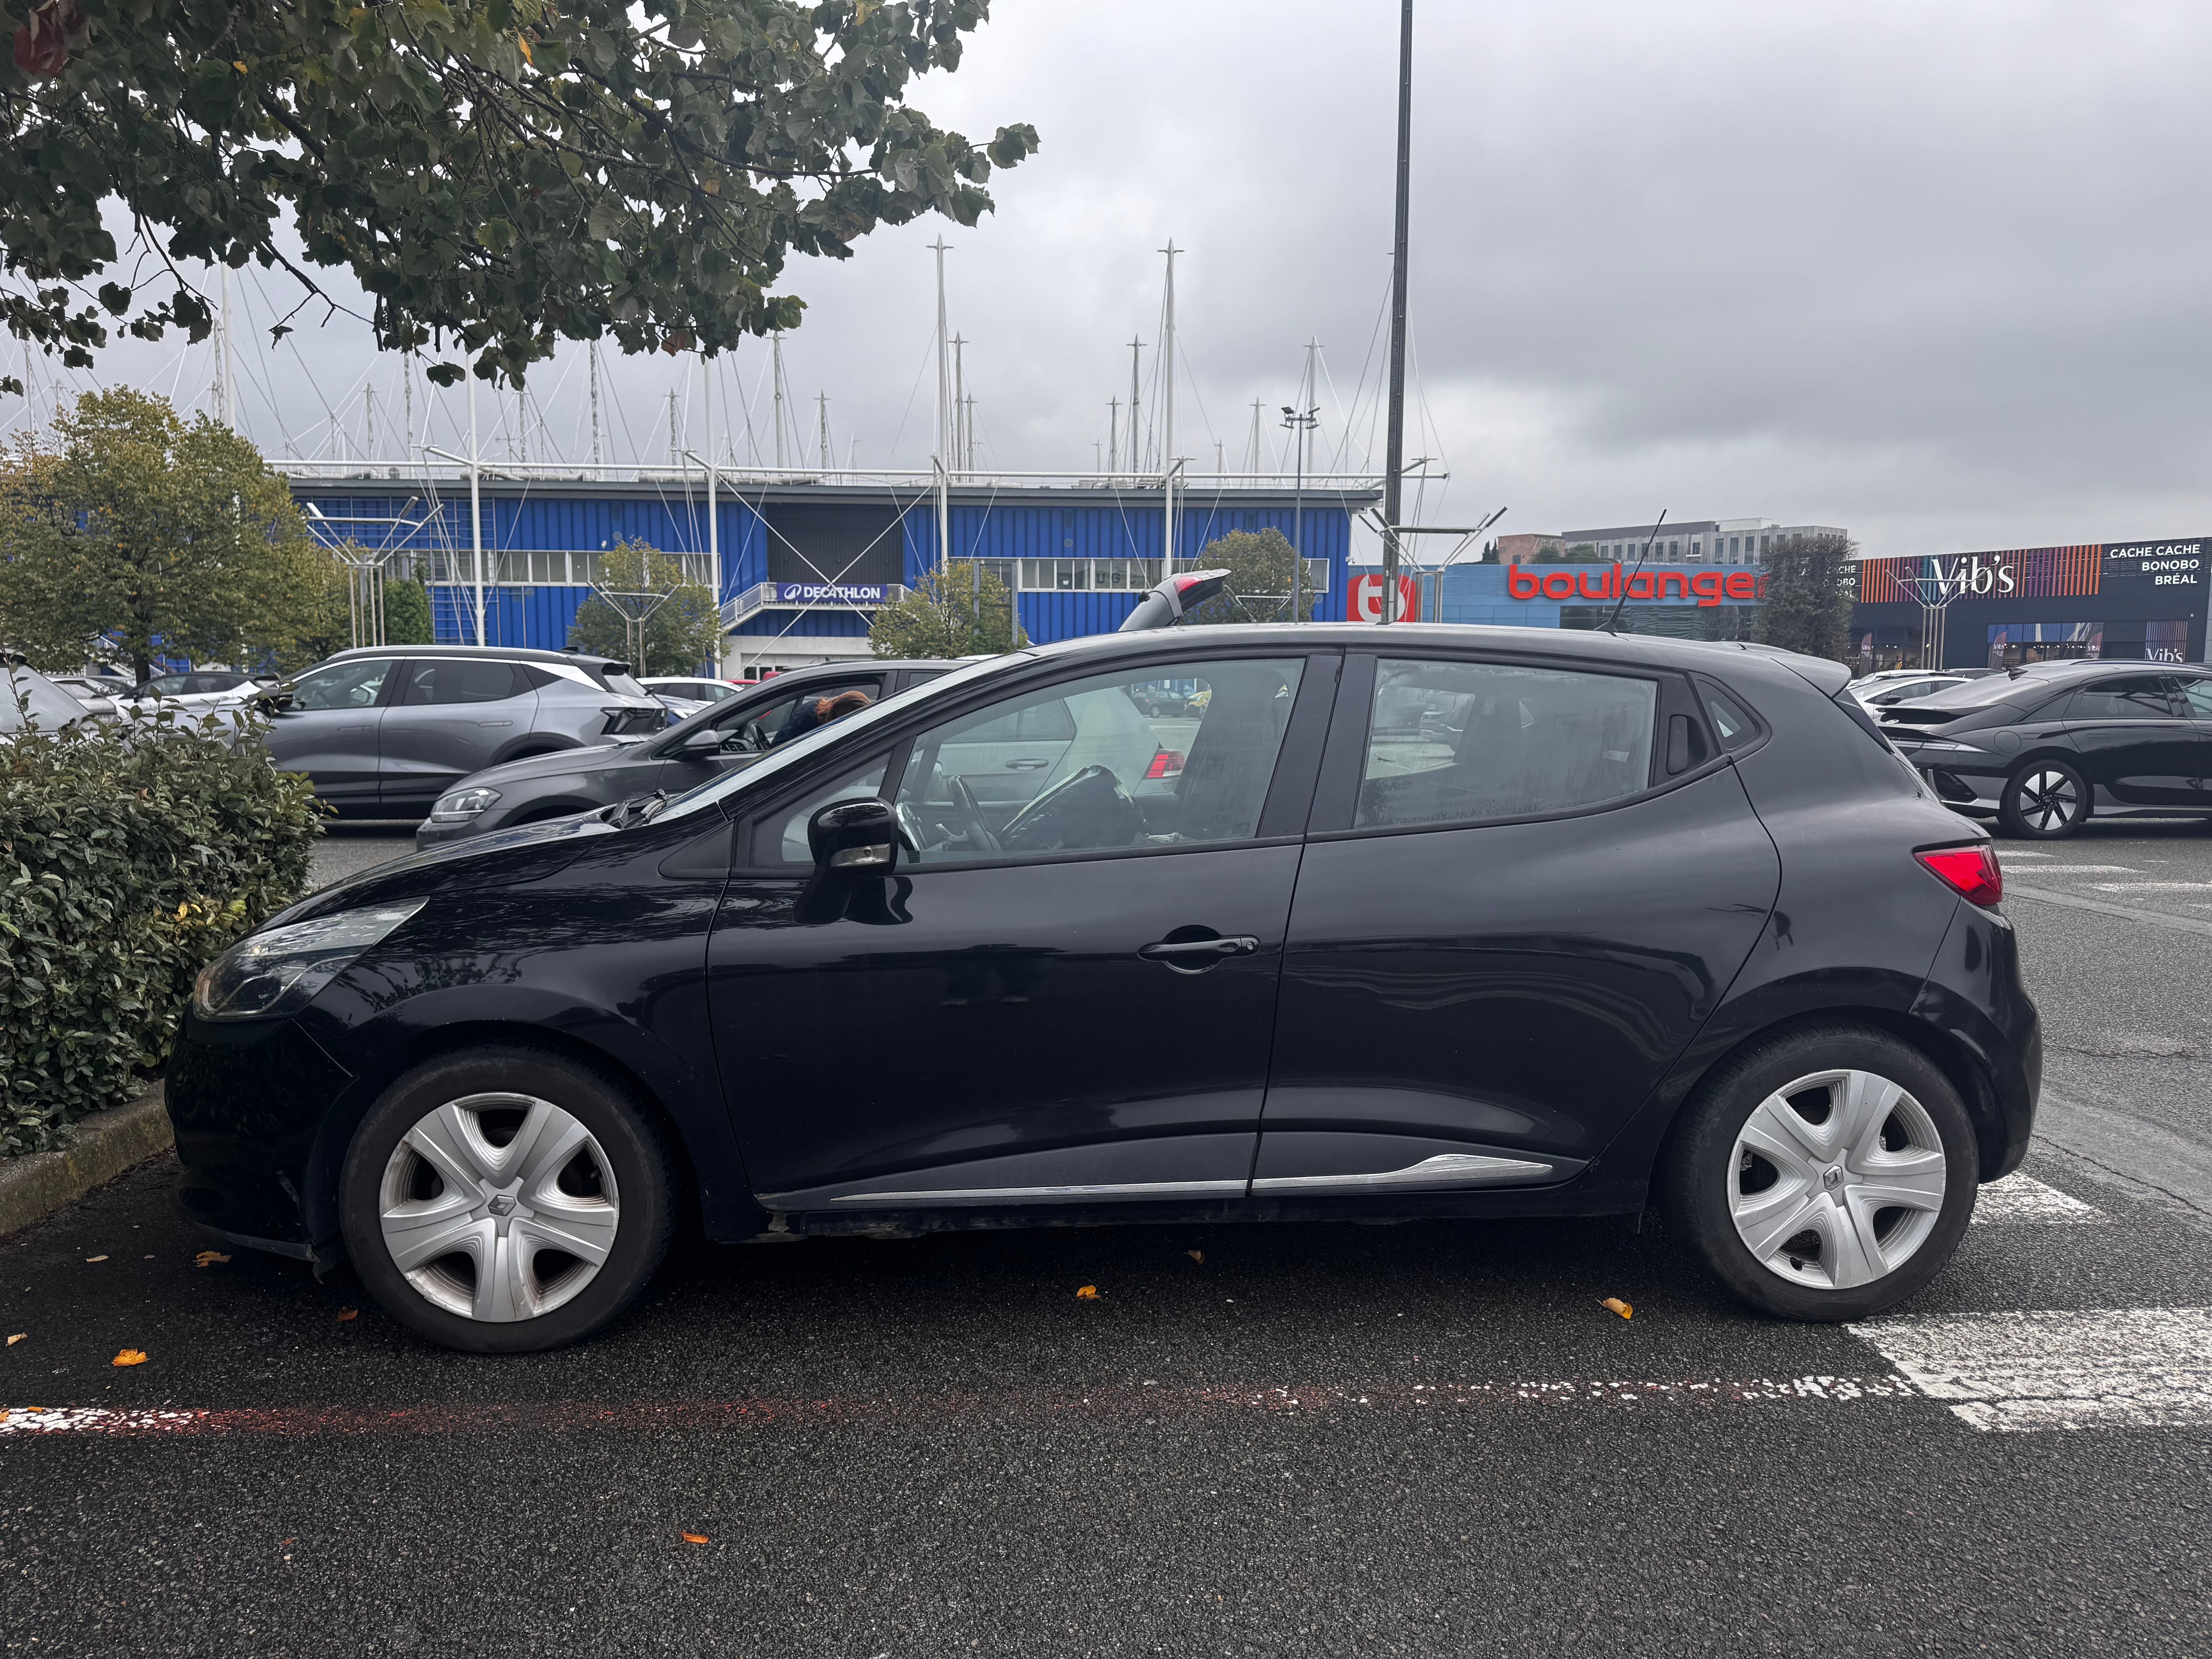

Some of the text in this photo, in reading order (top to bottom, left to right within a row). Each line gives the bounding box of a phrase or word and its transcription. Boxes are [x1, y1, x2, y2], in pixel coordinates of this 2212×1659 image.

[2111, 544, 2200, 558] CACHE CACHE
[2142, 559, 2199, 571] BONOBO
[1931, 555, 2014, 595] Vib's
[2155, 572, 2197, 585] BRÉAL
[804, 586, 880, 599] DECATHLON
[2147, 648, 2183, 663] Vib's
